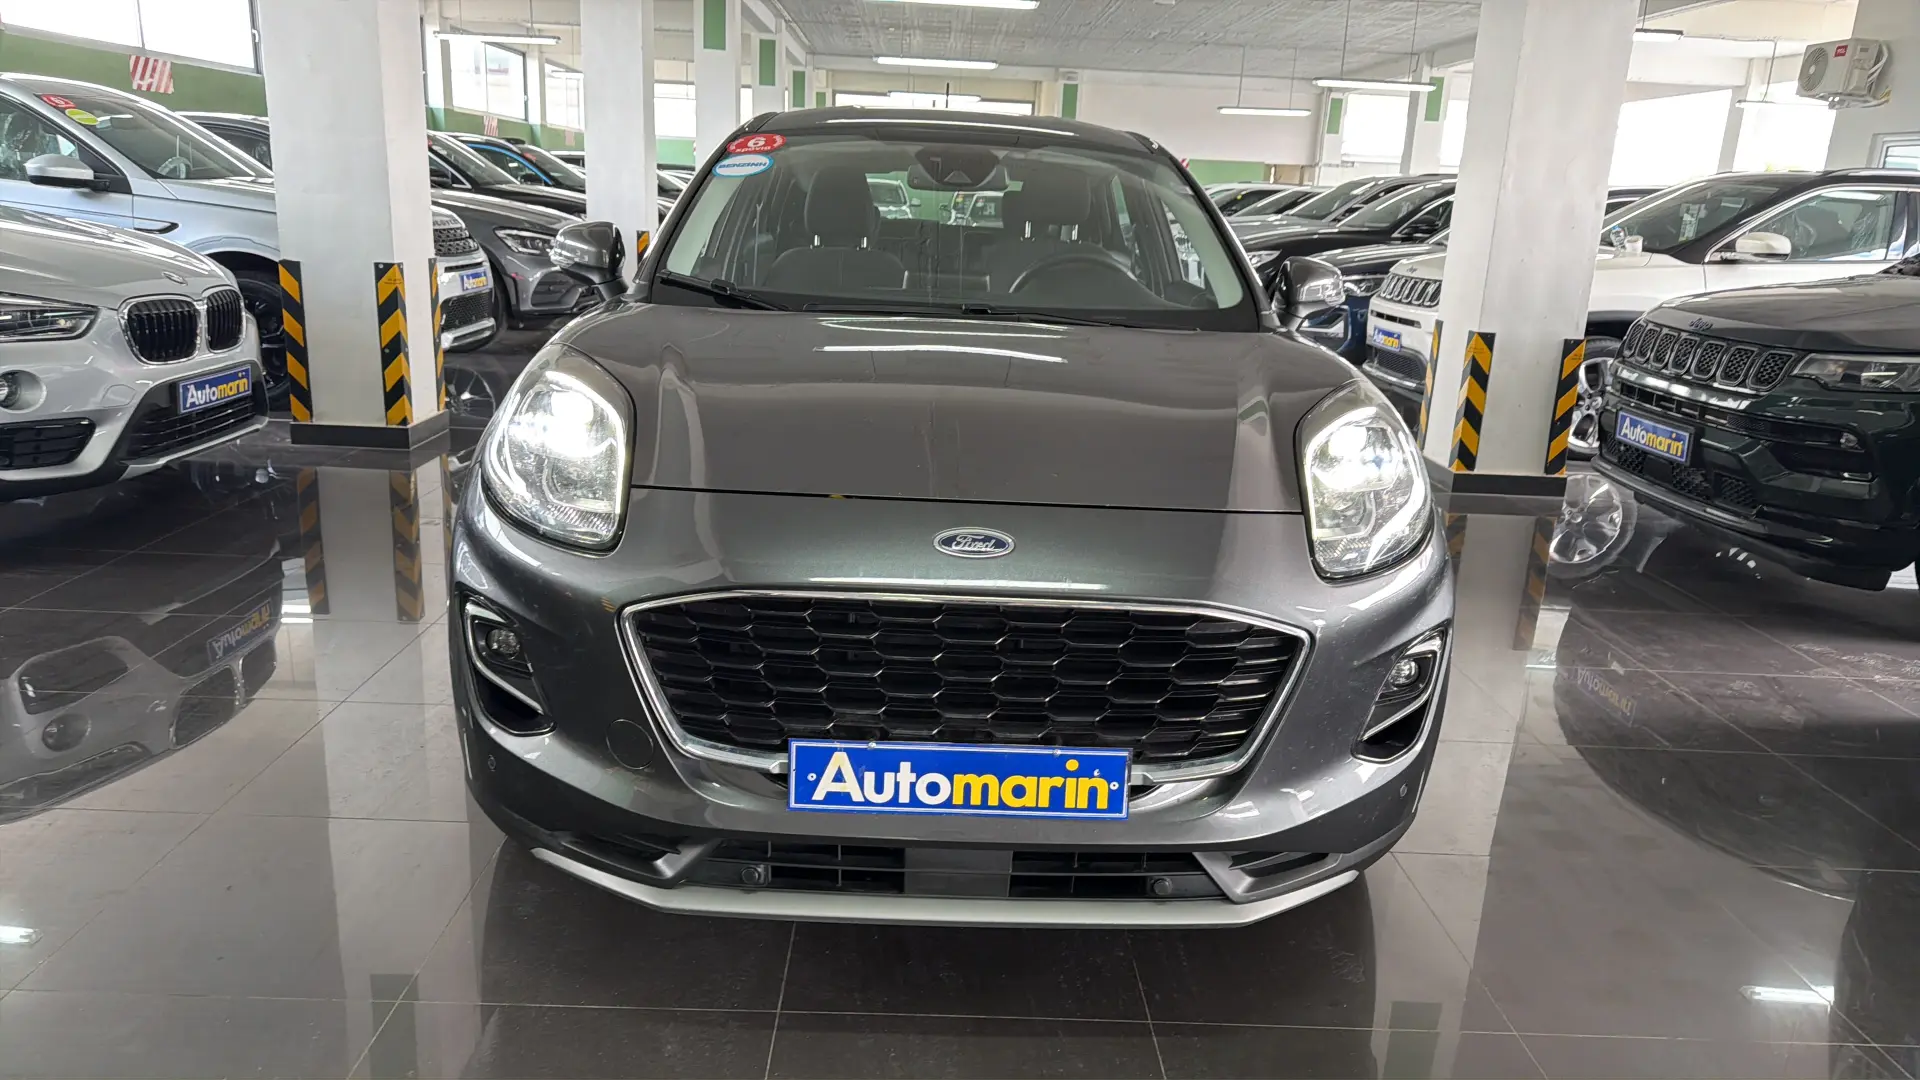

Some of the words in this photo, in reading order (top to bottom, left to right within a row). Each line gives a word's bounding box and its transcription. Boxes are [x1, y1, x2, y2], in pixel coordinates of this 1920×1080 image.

[747, 137, 766, 147] 6
[186, 371, 249, 408] Automarin
[1620, 416, 1683, 457] Automarin
[951, 534, 997, 551] Ford
[811, 751, 1109, 810] Automarin
